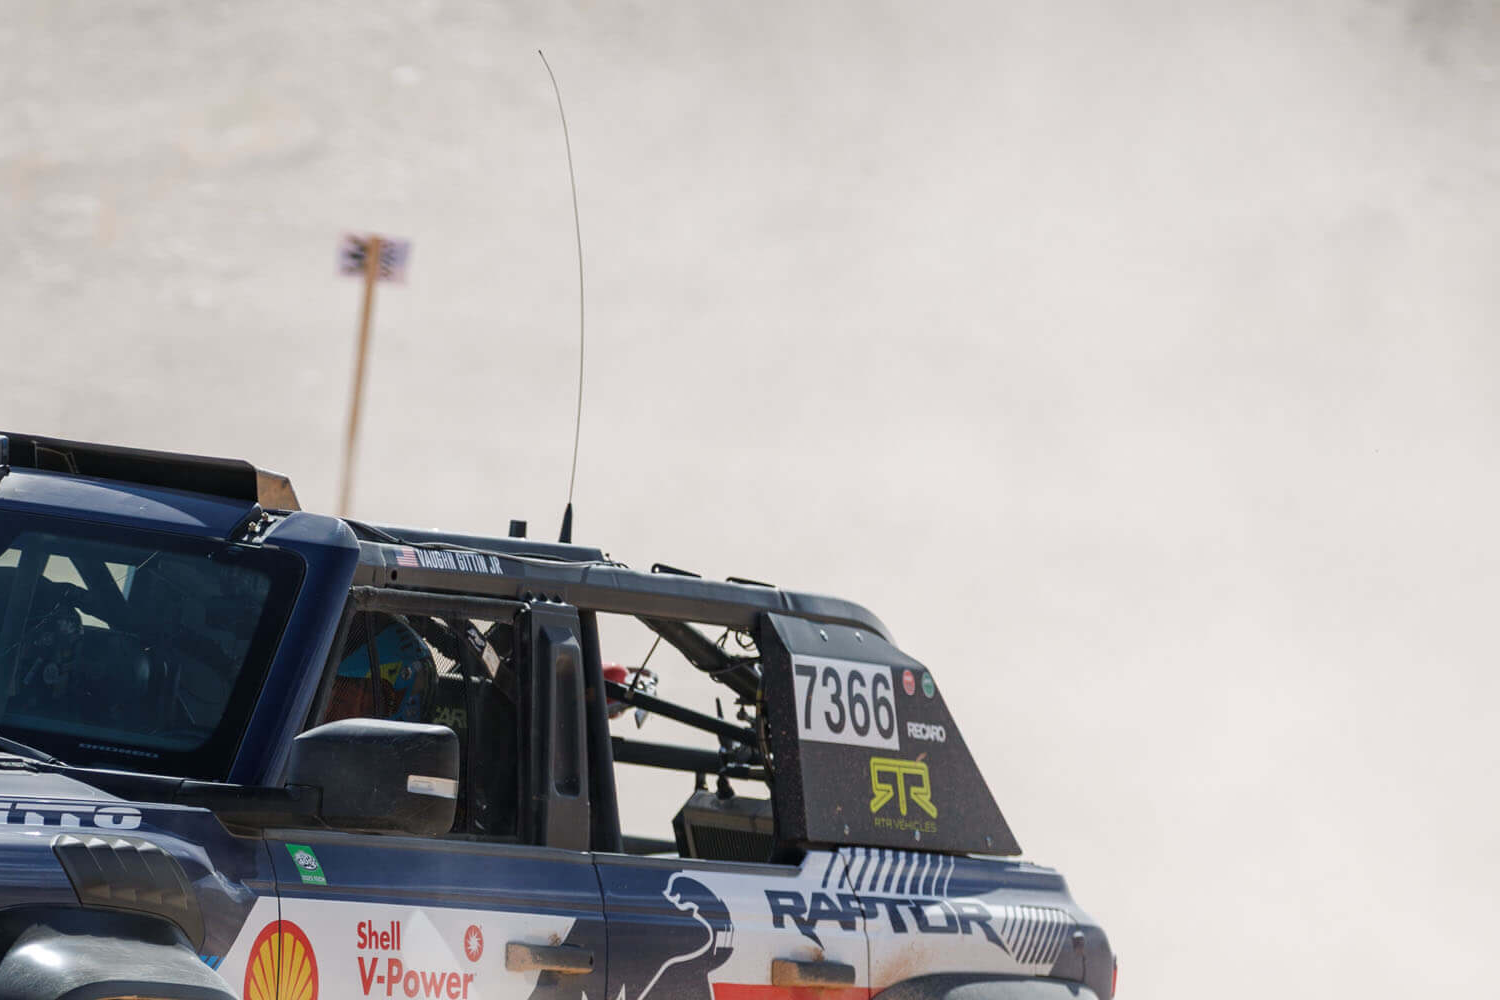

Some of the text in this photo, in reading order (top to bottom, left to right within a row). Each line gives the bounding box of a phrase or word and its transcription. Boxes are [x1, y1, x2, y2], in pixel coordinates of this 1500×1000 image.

[415, 549, 503, 575] VAUGHN GITTIN JR
[795, 664, 894, 740] 7366
[907, 721, 946, 743] RECARO
[893, 819, 938, 833] VEHICLES
[357, 919, 401, 951] Shell
[764, 889, 1012, 957] RAPTOR
[357, 956, 475, 1000] V-Power
